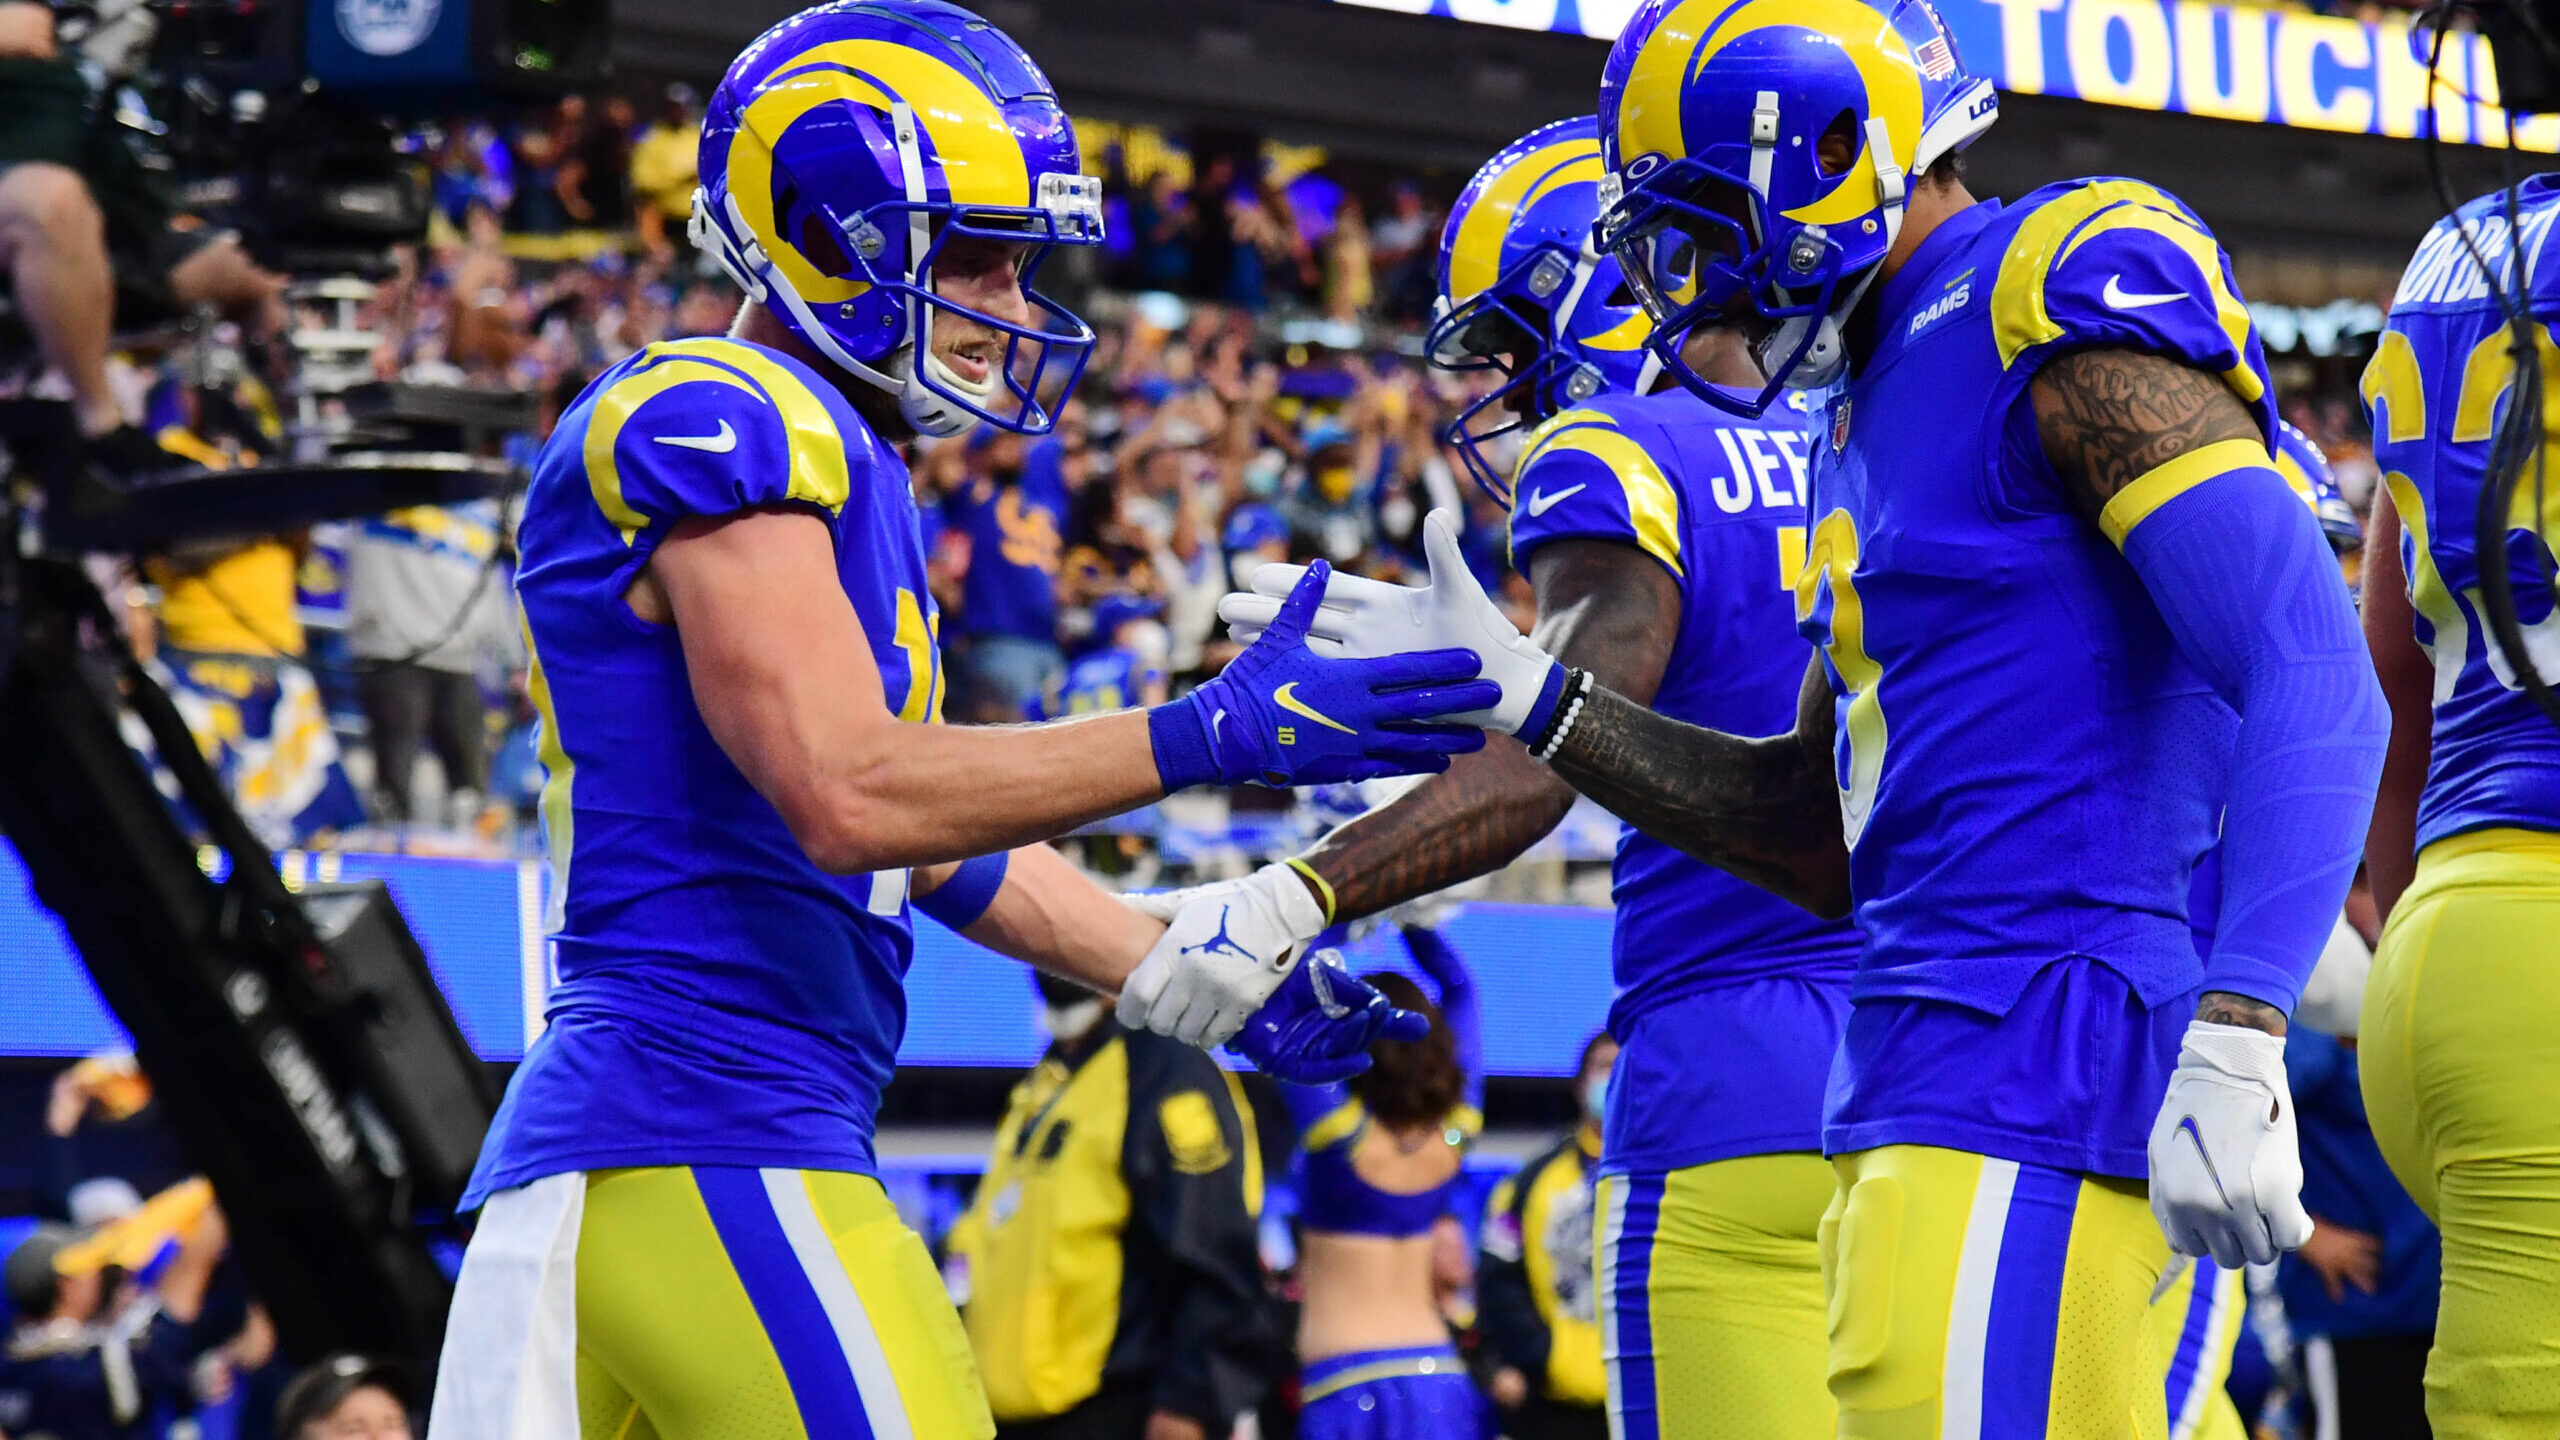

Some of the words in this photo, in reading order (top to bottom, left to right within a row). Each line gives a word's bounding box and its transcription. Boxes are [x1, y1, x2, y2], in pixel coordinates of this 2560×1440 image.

[1910, 283, 1970, 335] RAMS
[1710, 427, 1808, 514] JEF
[1278, 726, 1295, 745] 10
